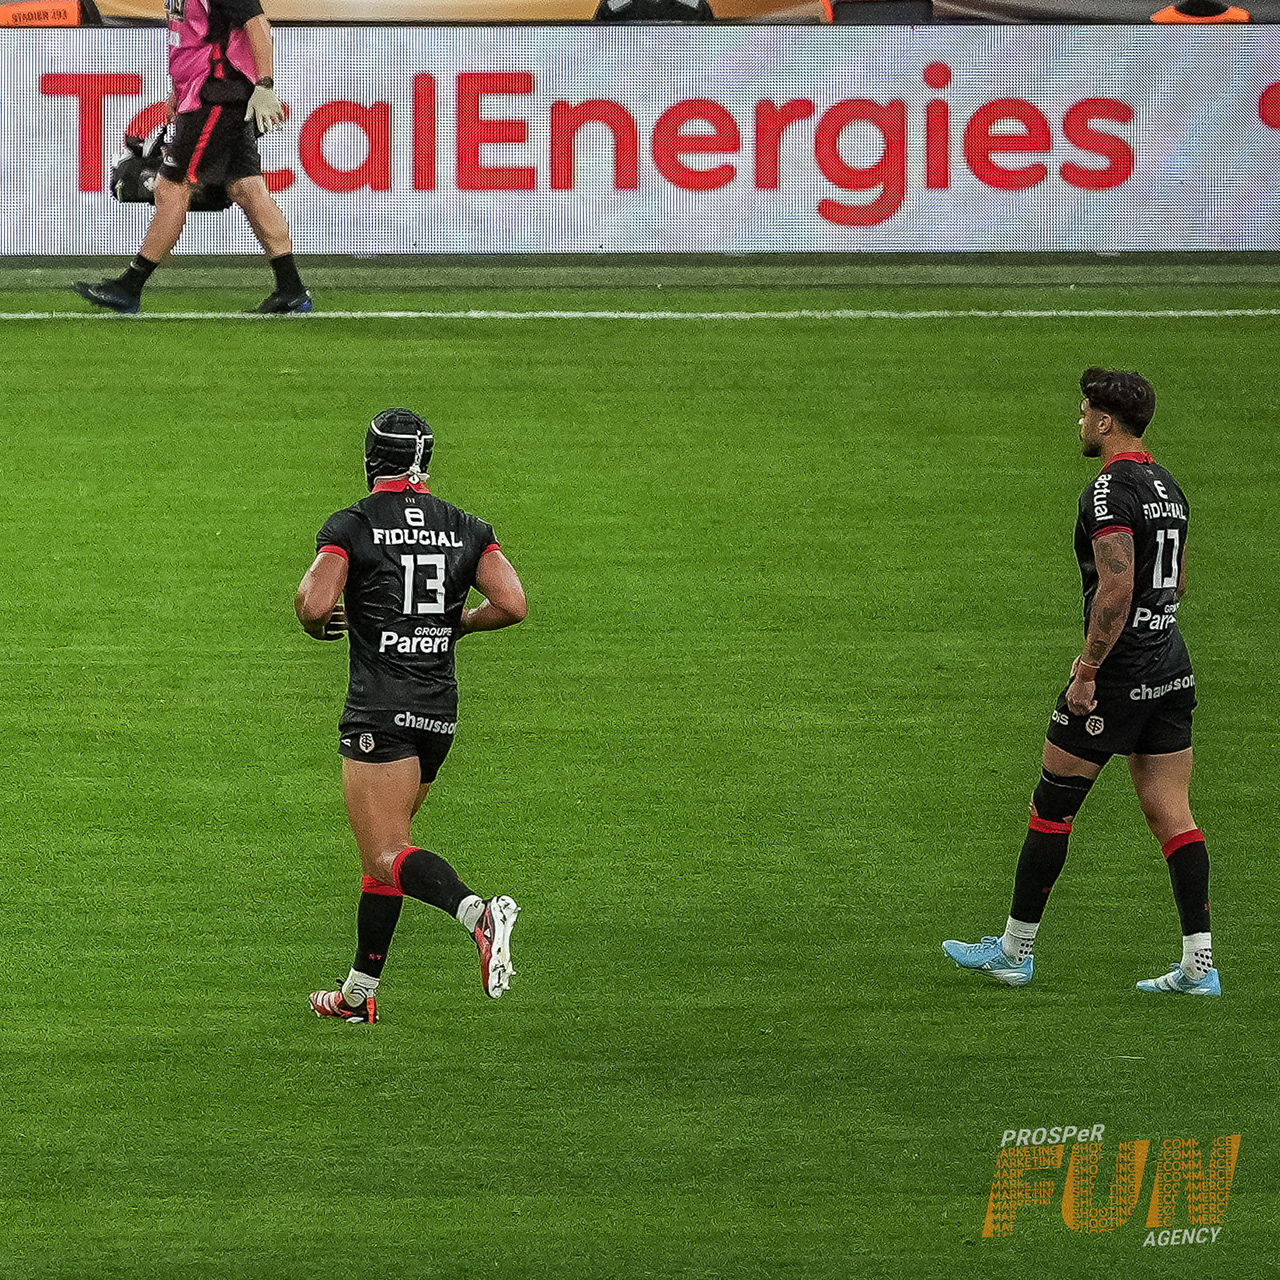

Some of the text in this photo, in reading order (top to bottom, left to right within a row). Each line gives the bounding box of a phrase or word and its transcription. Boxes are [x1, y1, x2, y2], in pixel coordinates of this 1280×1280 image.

[40, 63, 1134, 226] TalEnergies
[1094, 473, 1115, 521] actual
[373, 528, 463, 548] FIDUCIAL
[400, 554, 446, 615] 13
[379, 630, 449, 654] Parera
[414, 626, 453, 636] GROUPE
[394, 711, 457, 734] chausso
